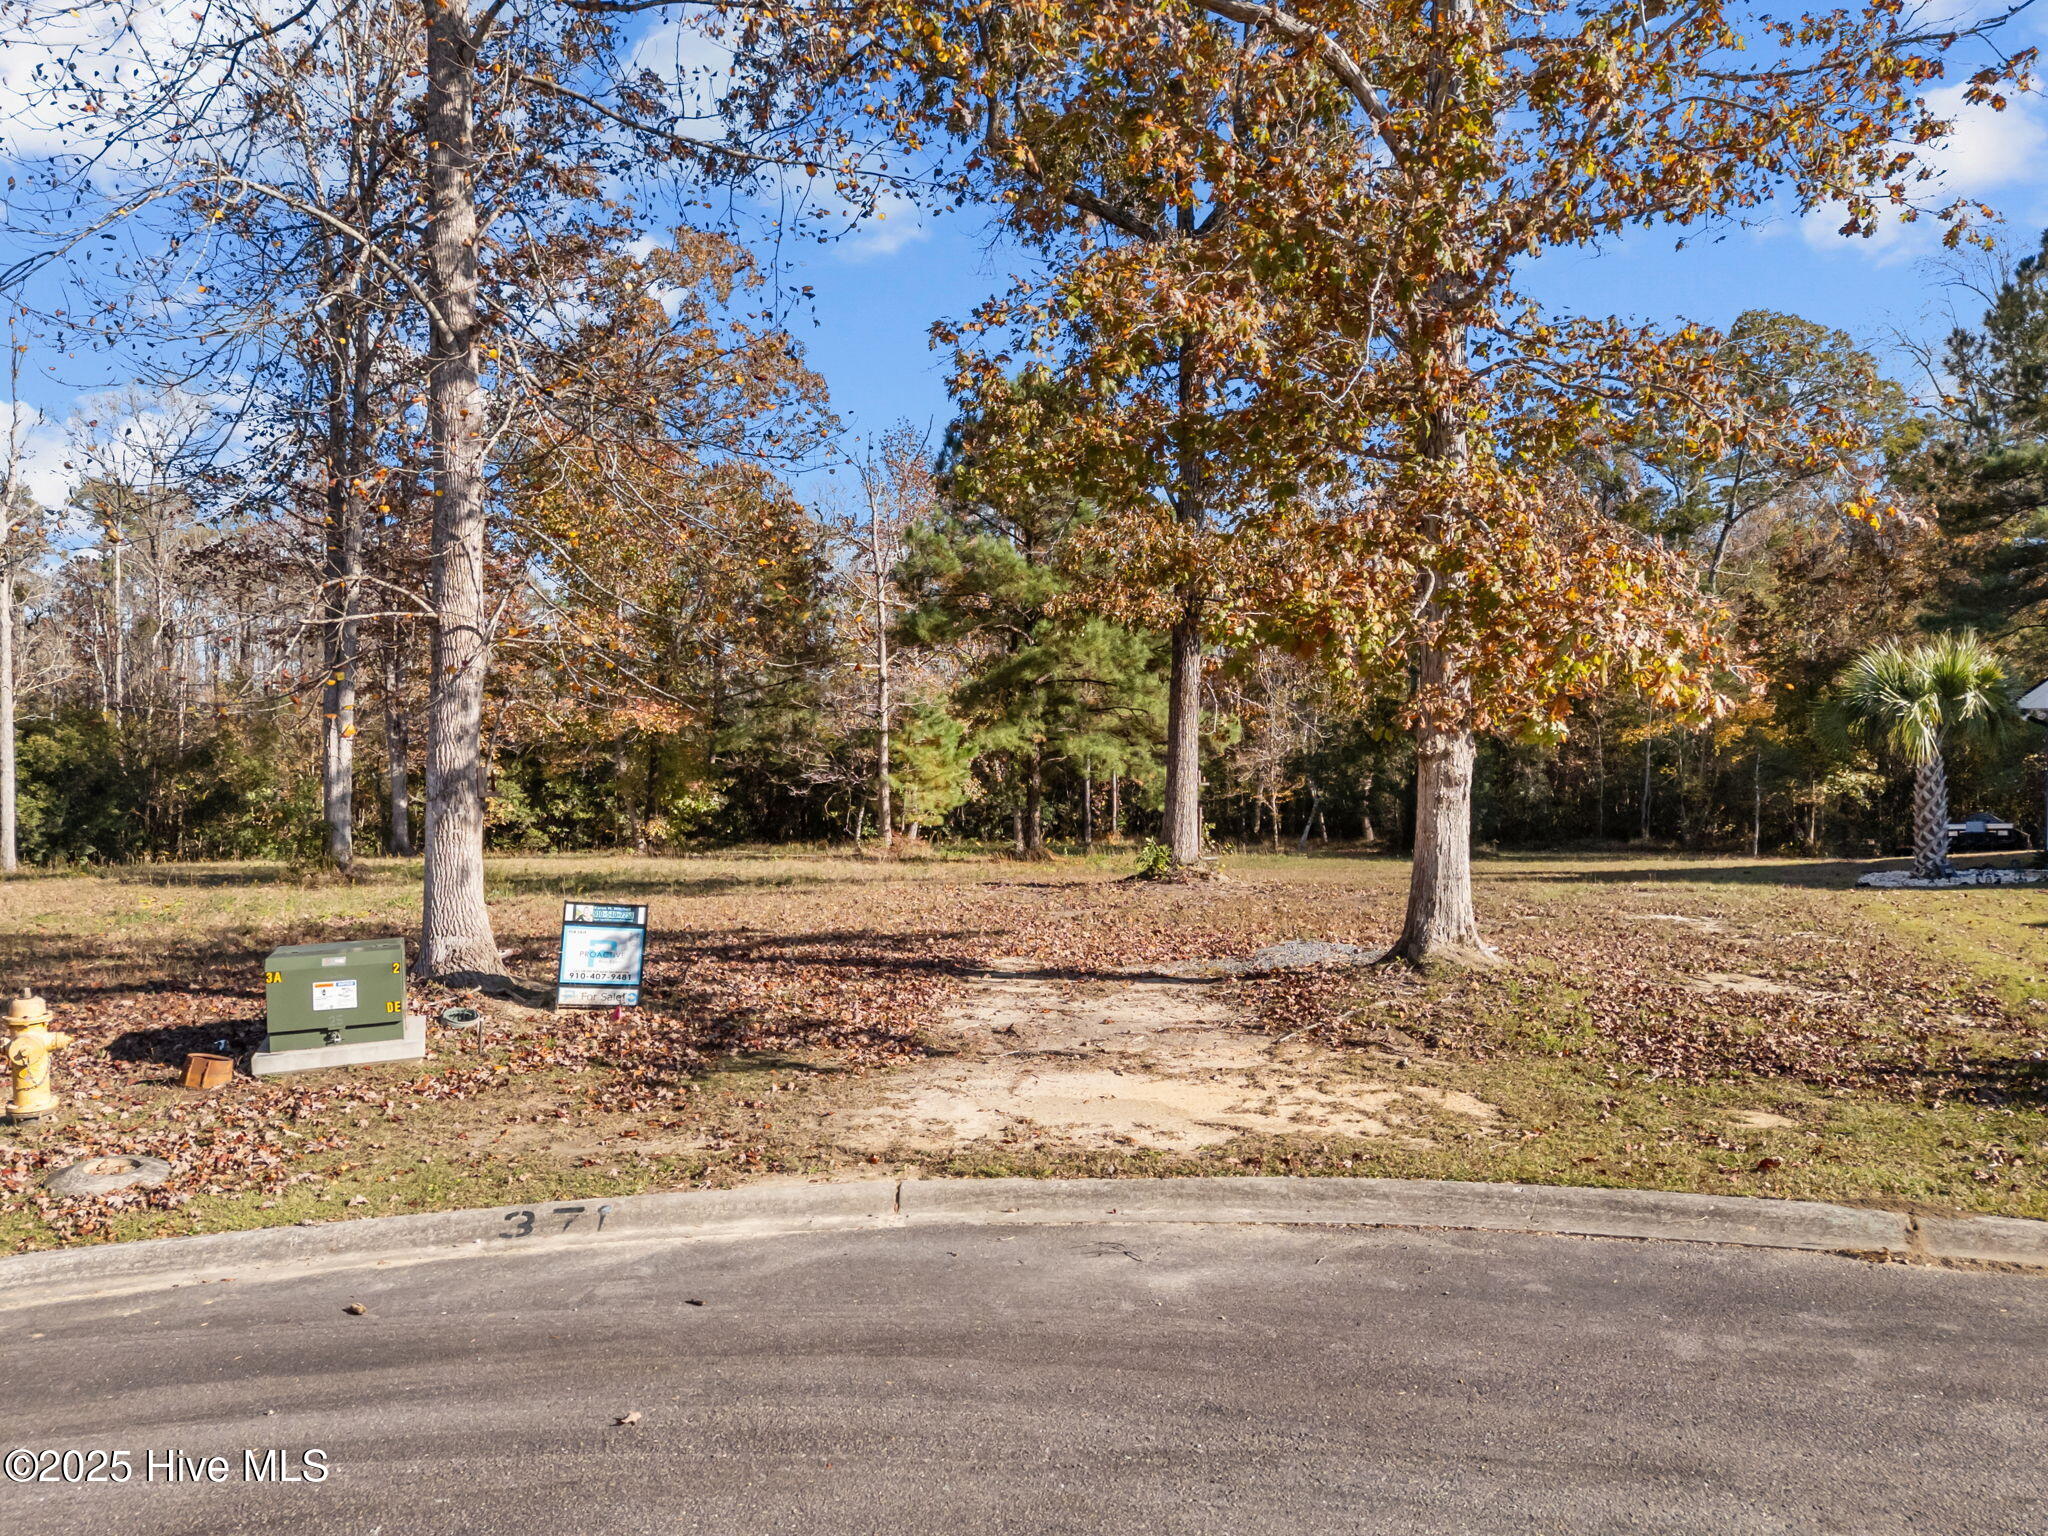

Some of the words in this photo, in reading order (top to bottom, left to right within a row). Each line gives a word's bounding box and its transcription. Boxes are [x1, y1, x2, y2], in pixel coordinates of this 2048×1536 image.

[392, 962, 401, 974] 2
[265, 971, 282, 984] 3A
[569, 973, 632, 981] 910-407-9481
[581, 991, 597, 1001] For
[386, 1001, 402, 1013] DE
